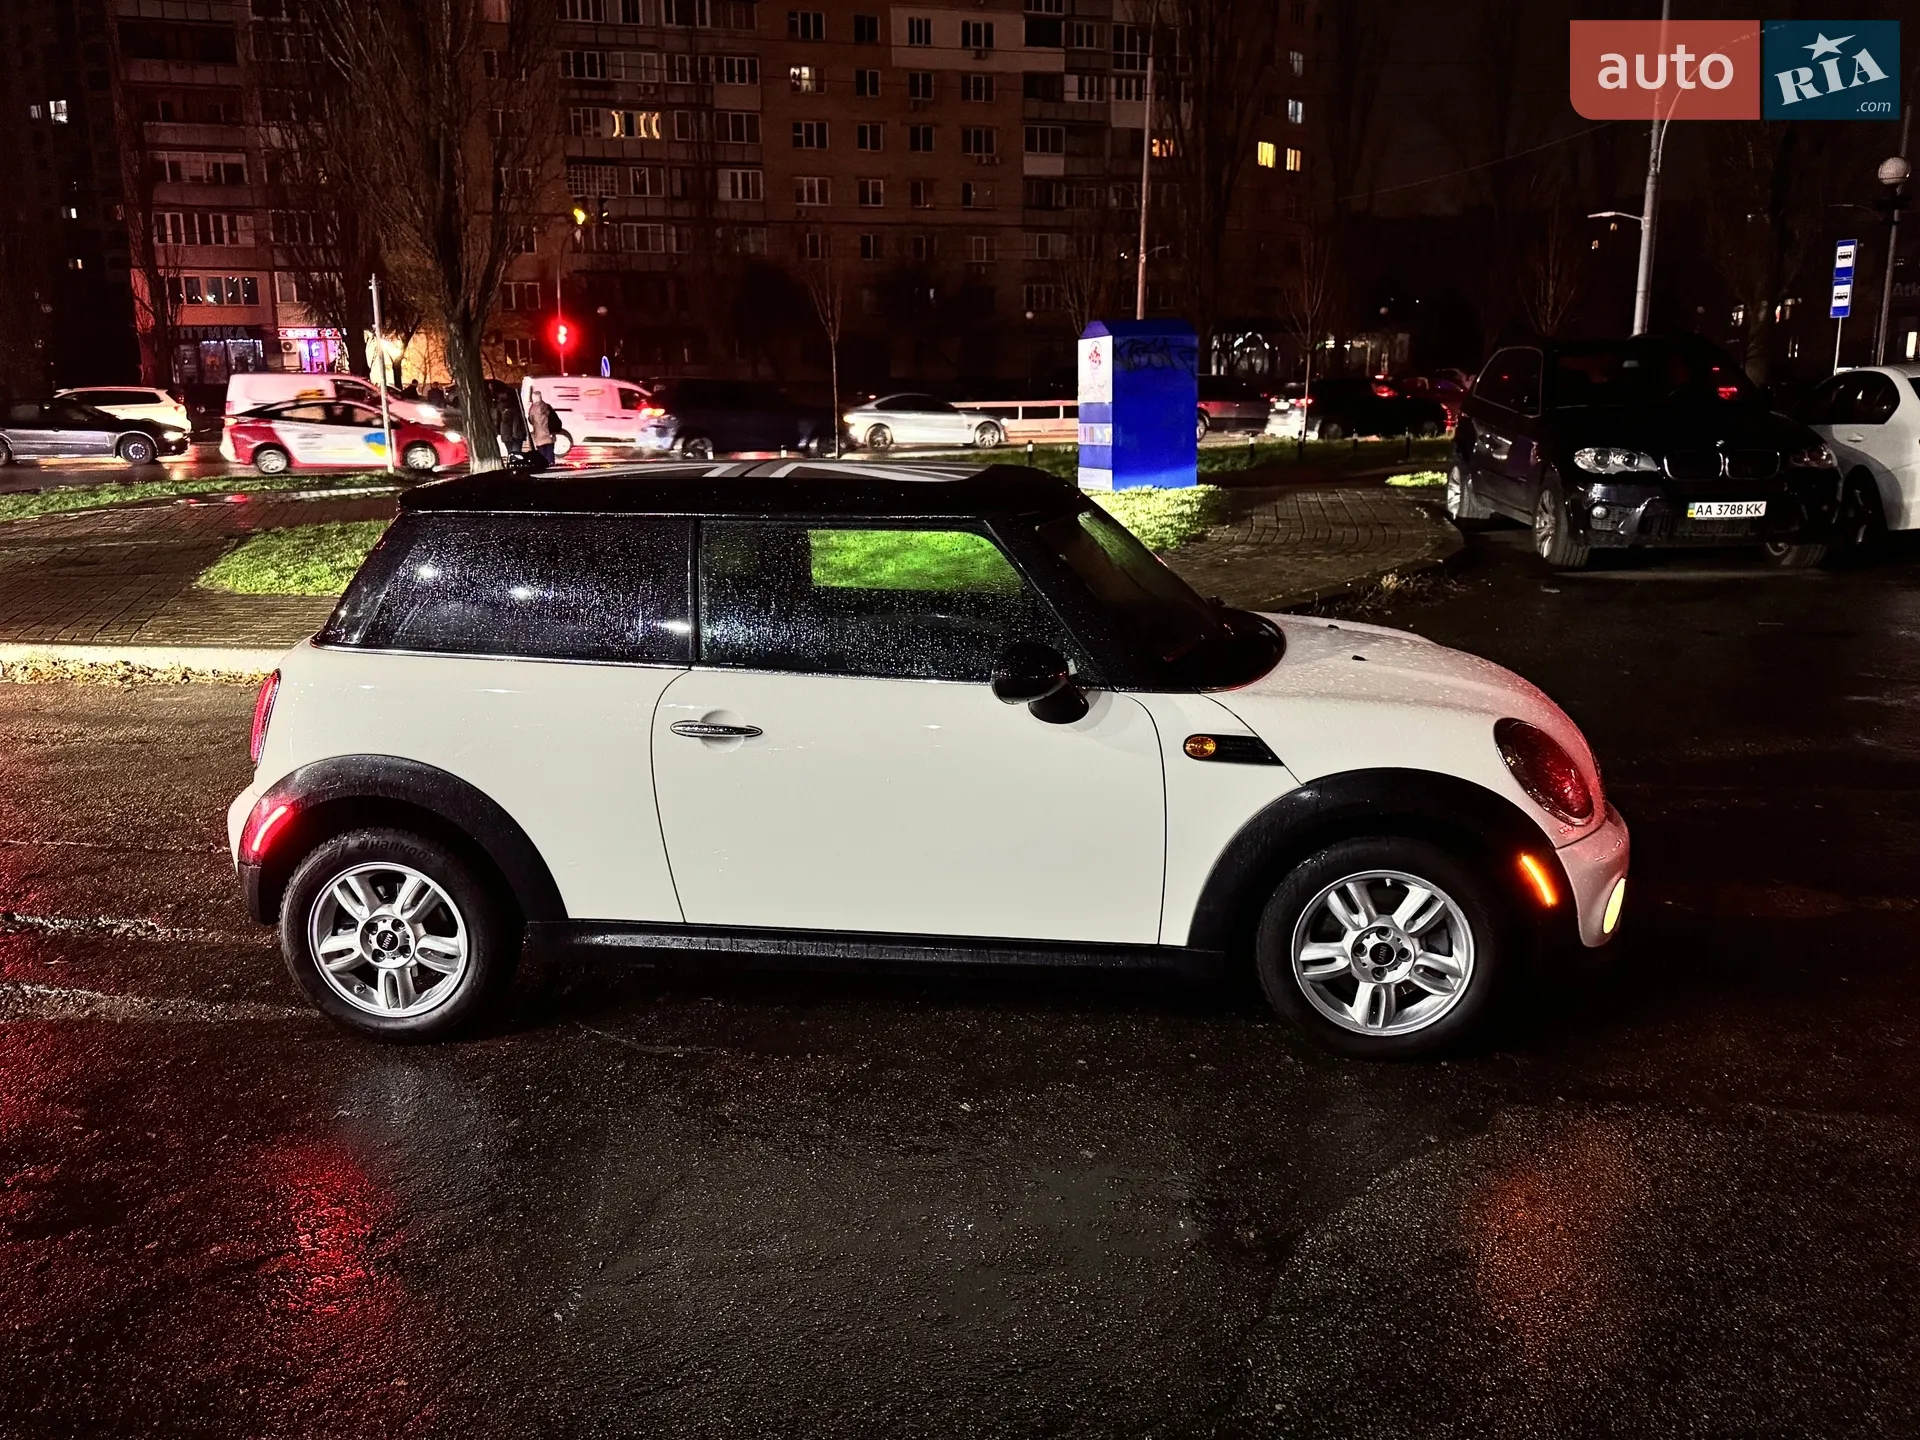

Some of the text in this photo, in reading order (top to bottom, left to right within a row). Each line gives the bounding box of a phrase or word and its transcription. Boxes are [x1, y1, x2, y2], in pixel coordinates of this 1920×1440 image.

[1696, 503, 1763, 515] AA 3788 KK
[381, 932, 393, 949] MINI
